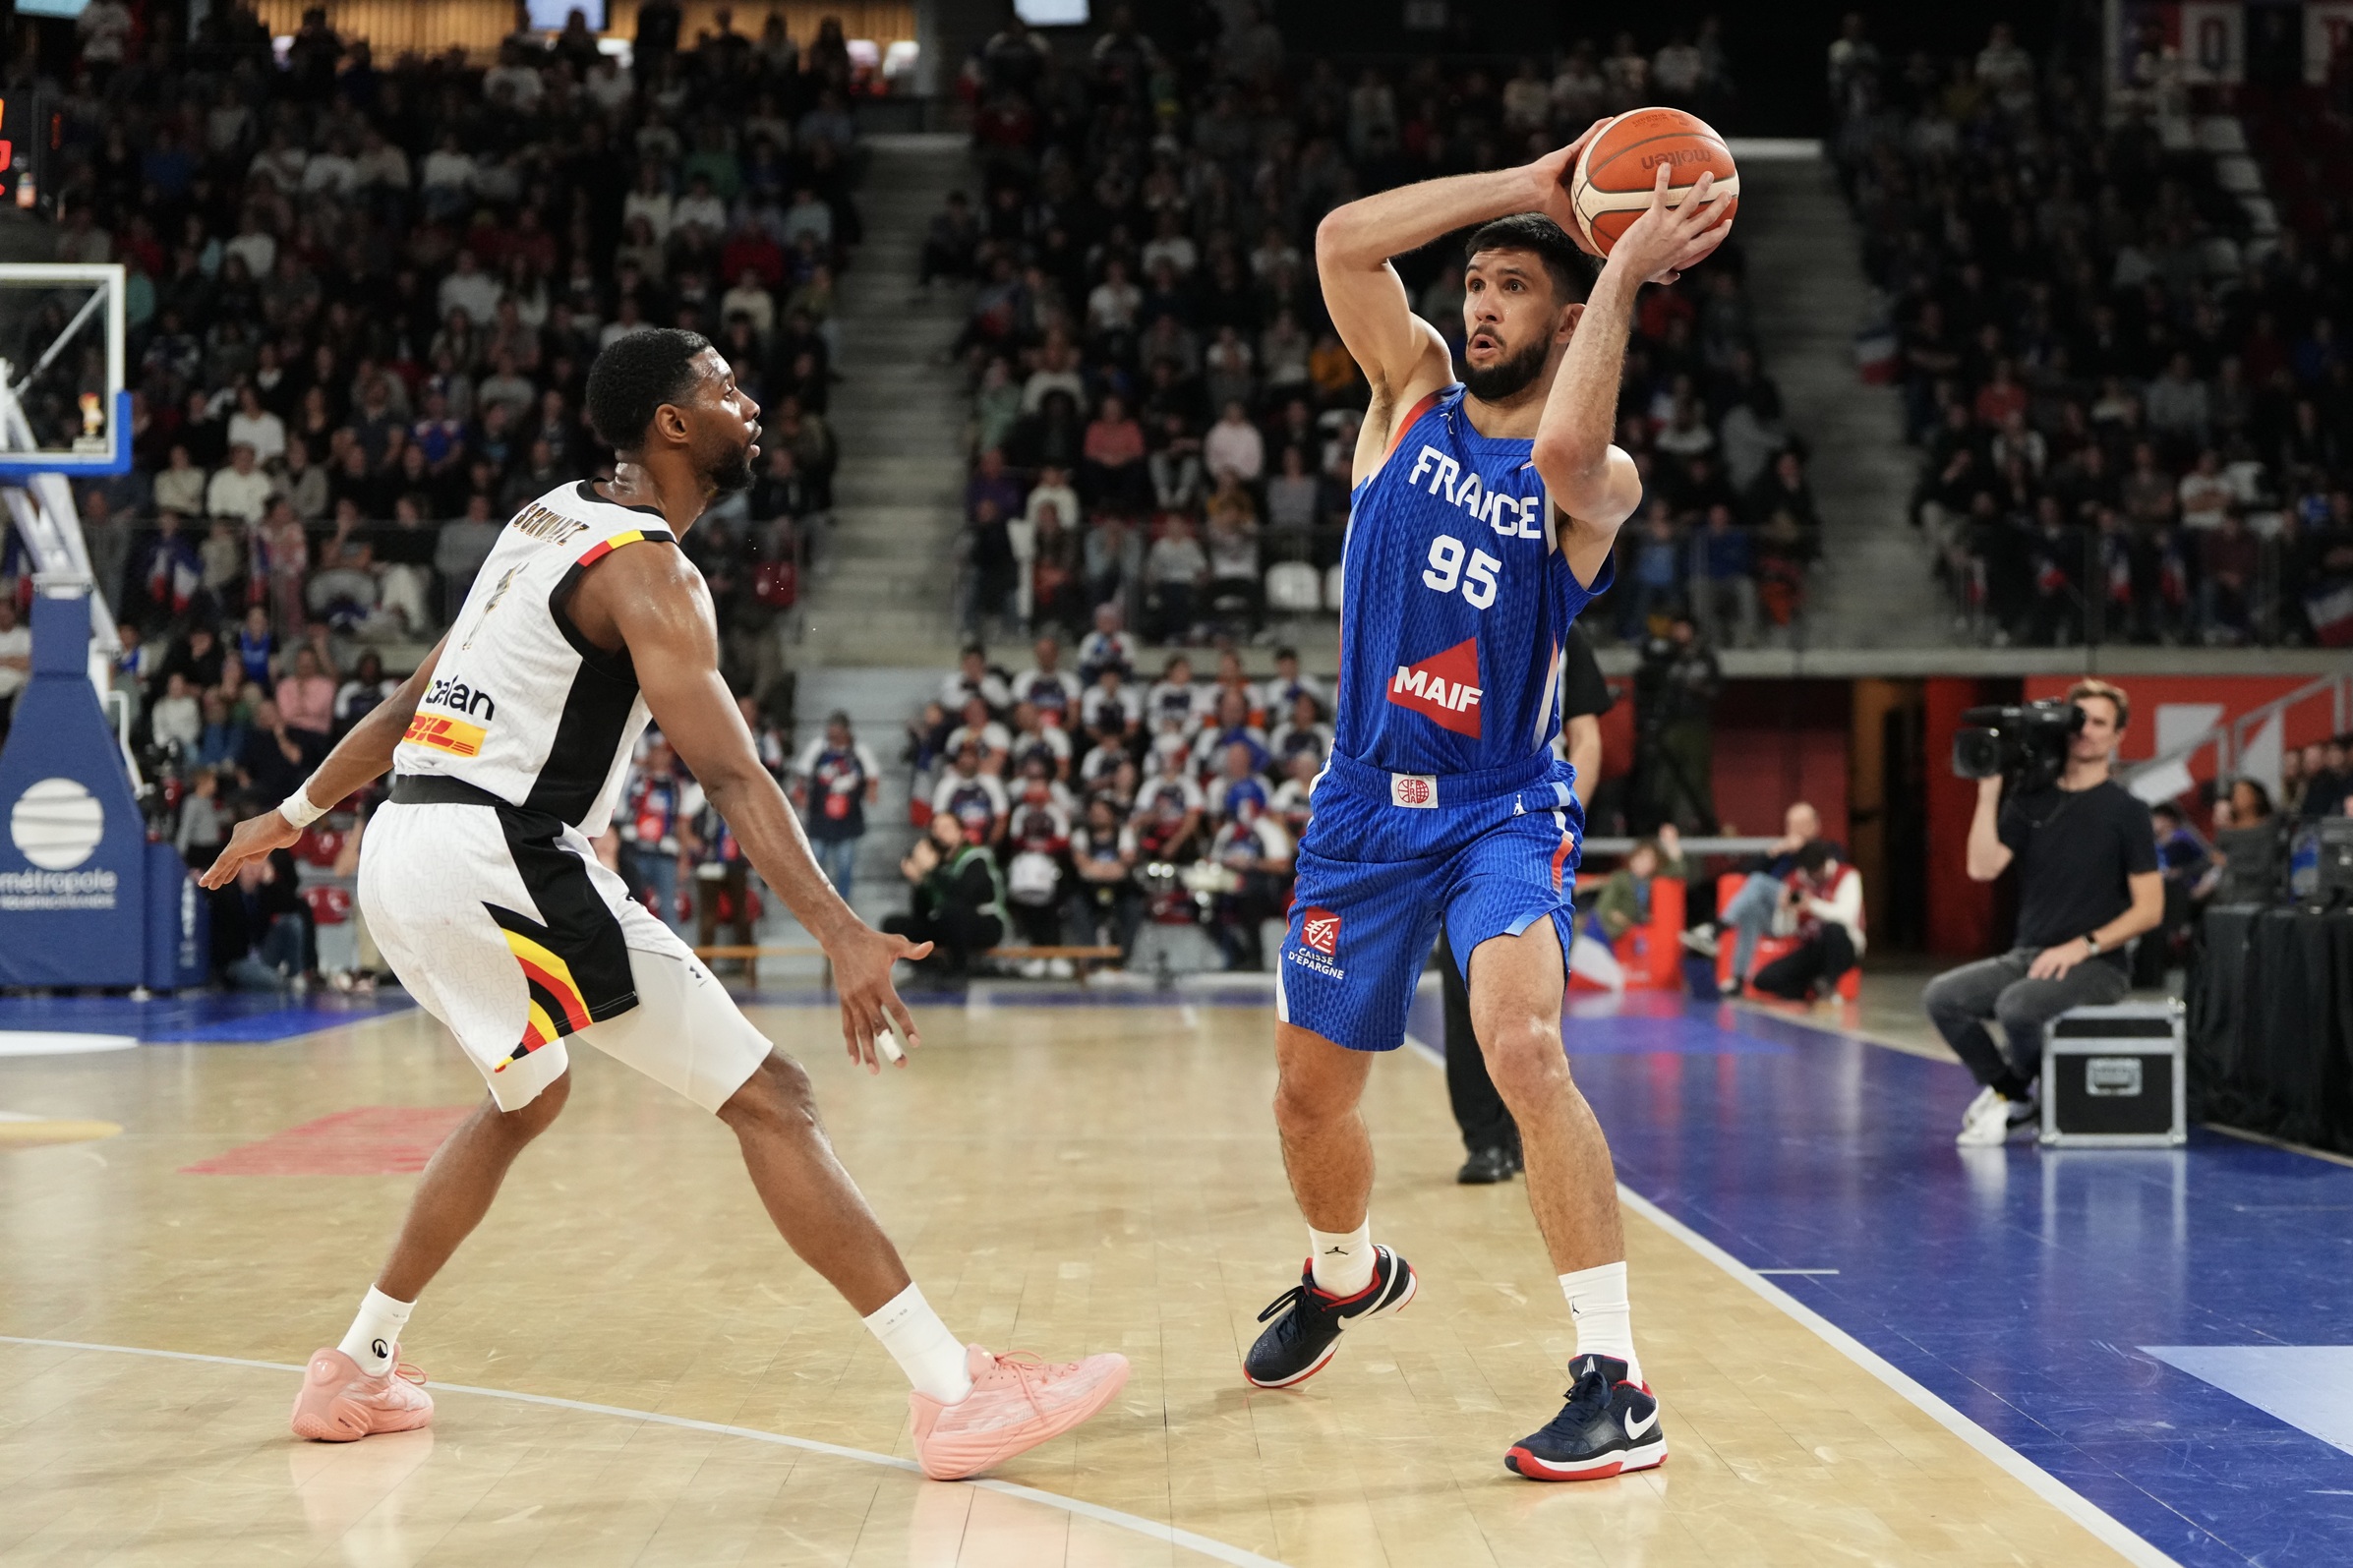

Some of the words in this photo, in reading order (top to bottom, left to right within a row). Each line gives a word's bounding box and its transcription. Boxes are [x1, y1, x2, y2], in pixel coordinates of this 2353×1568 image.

[1640, 147, 1712, 170] molten
[1408, 444, 1542, 540] FRANCE
[1422, 534, 1502, 610] 95
[1392, 666, 1484, 713] MAIF
[1287, 951, 1345, 980] D'EPARGNE
[1298, 947, 1334, 966] CAISSE
